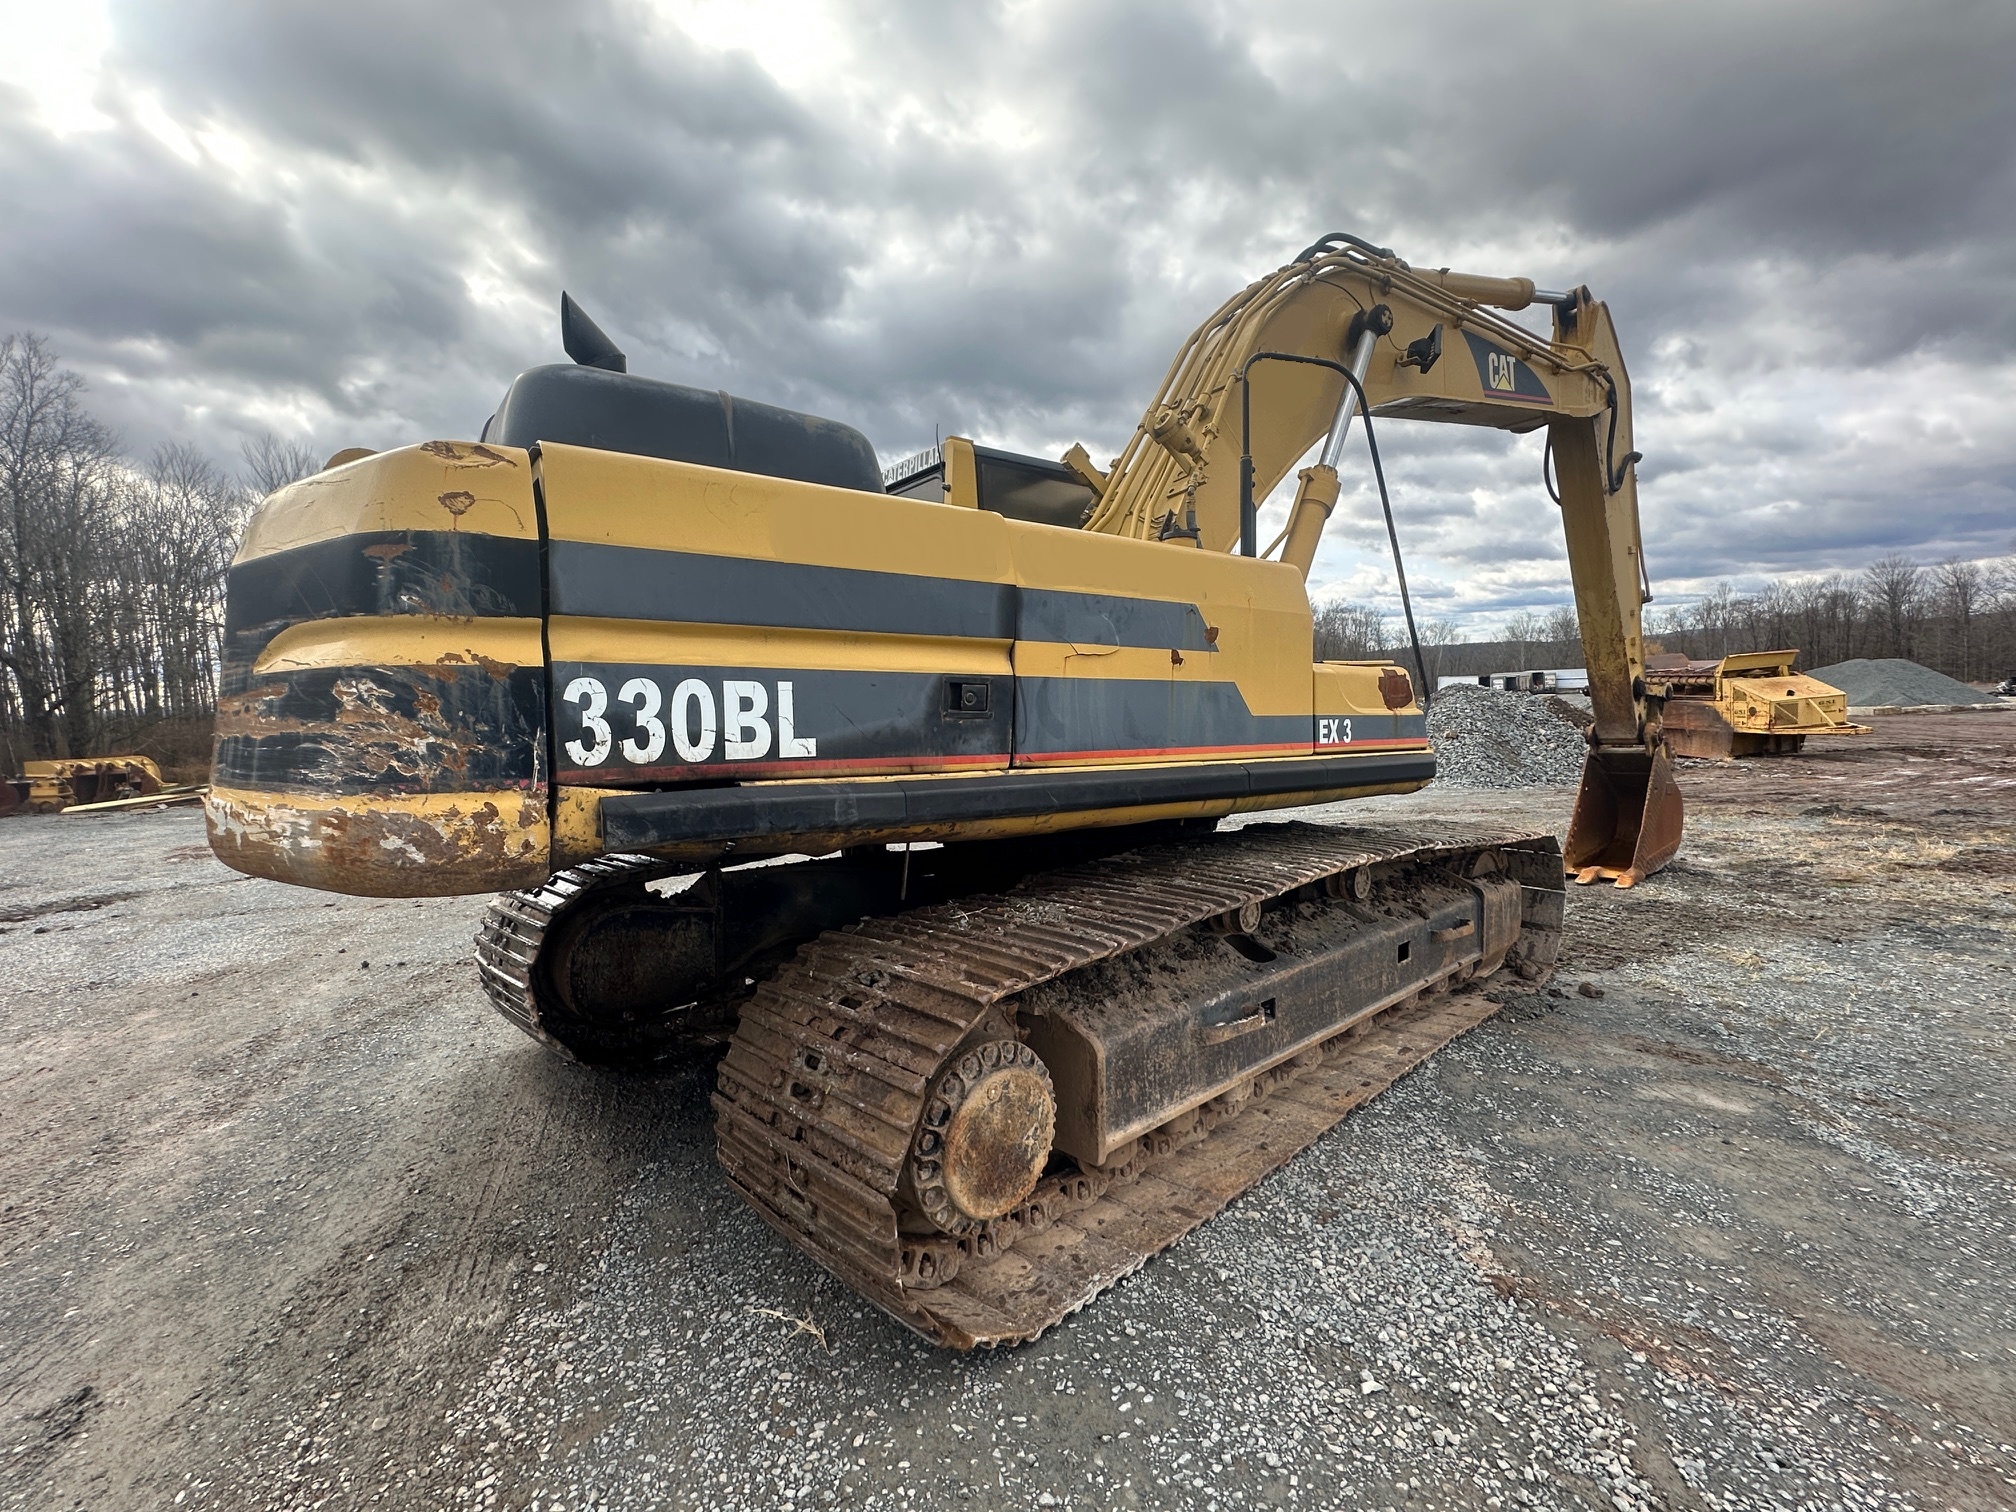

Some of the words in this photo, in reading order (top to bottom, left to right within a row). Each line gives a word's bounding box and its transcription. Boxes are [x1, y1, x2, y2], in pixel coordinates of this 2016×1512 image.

[1488, 352, 1516, 392] CAT
[563, 677, 817, 767] 330BL
[1319, 719, 1339, 744] EX
[1343, 718, 1352, 743] 3
